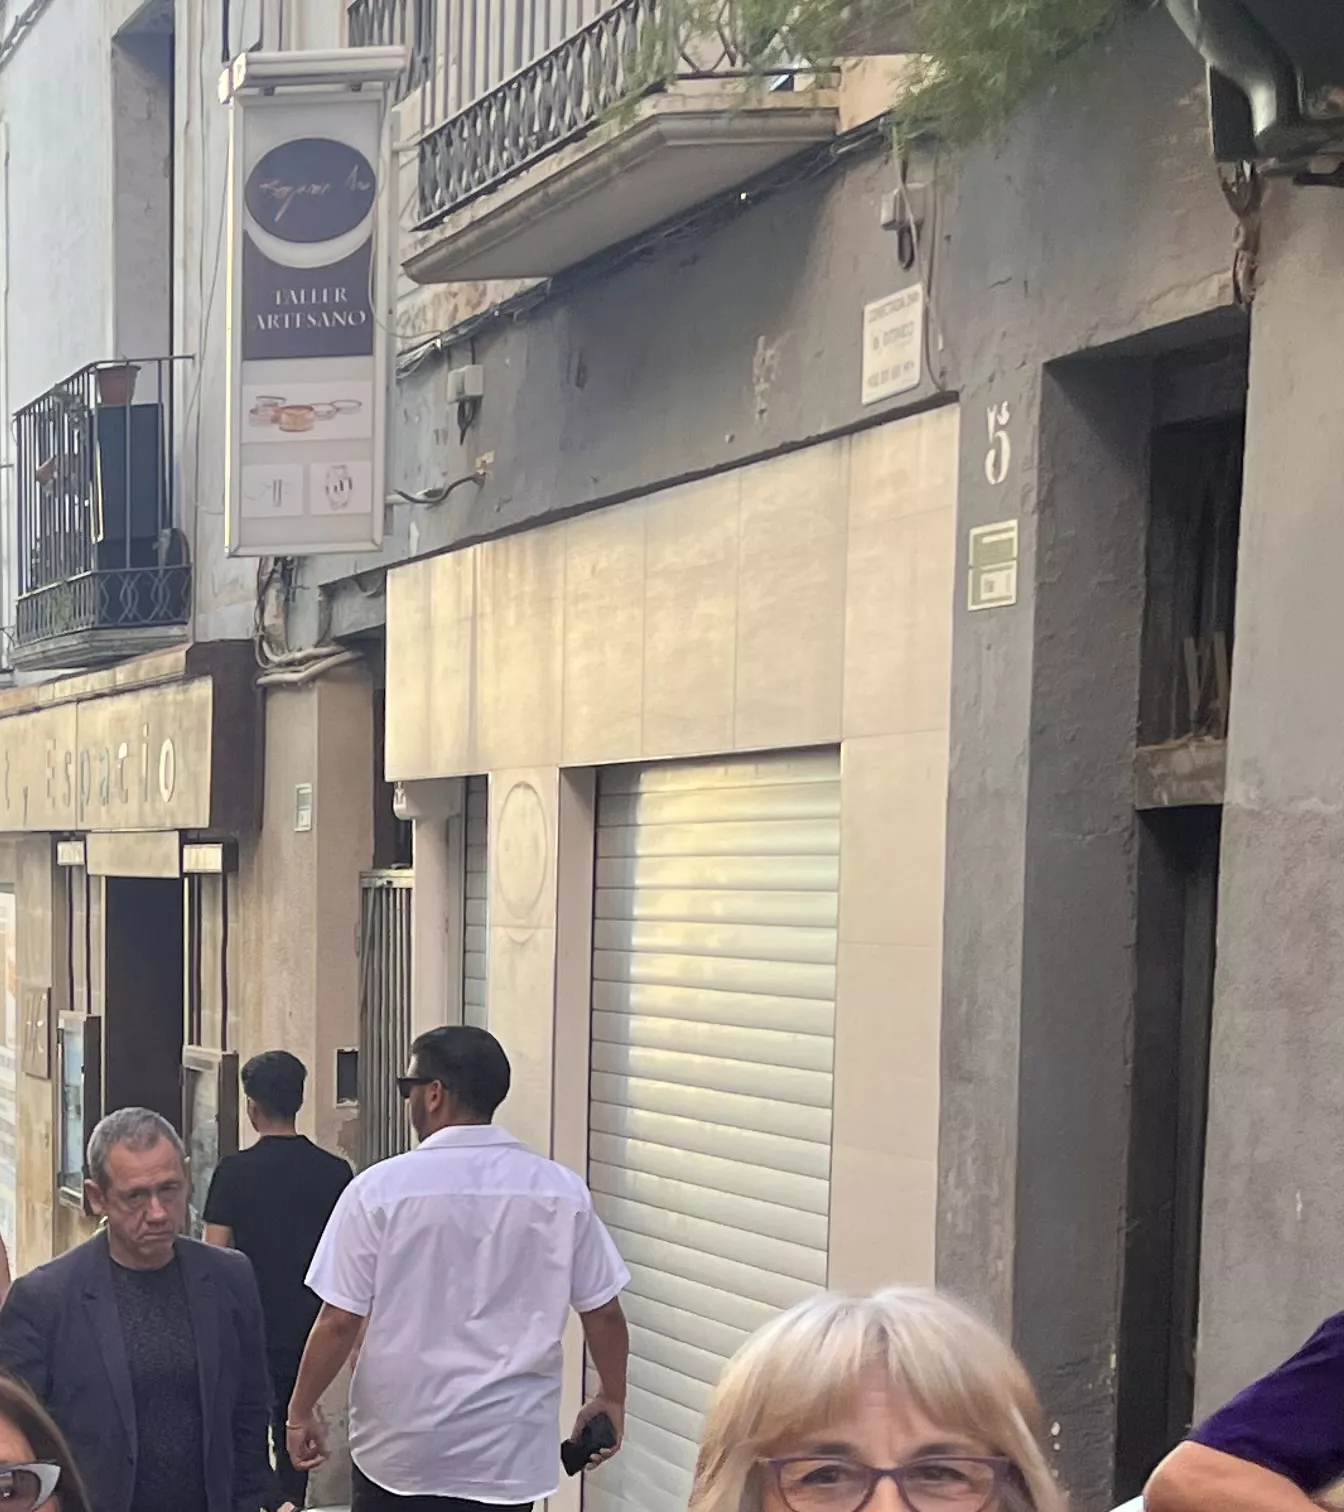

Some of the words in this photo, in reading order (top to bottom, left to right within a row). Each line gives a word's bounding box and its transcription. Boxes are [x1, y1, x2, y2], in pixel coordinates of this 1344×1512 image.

[274, 287, 348, 306] TALLER
[254, 309, 367, 330] ARTESANO
[45, 722, 177, 823] Espacio
